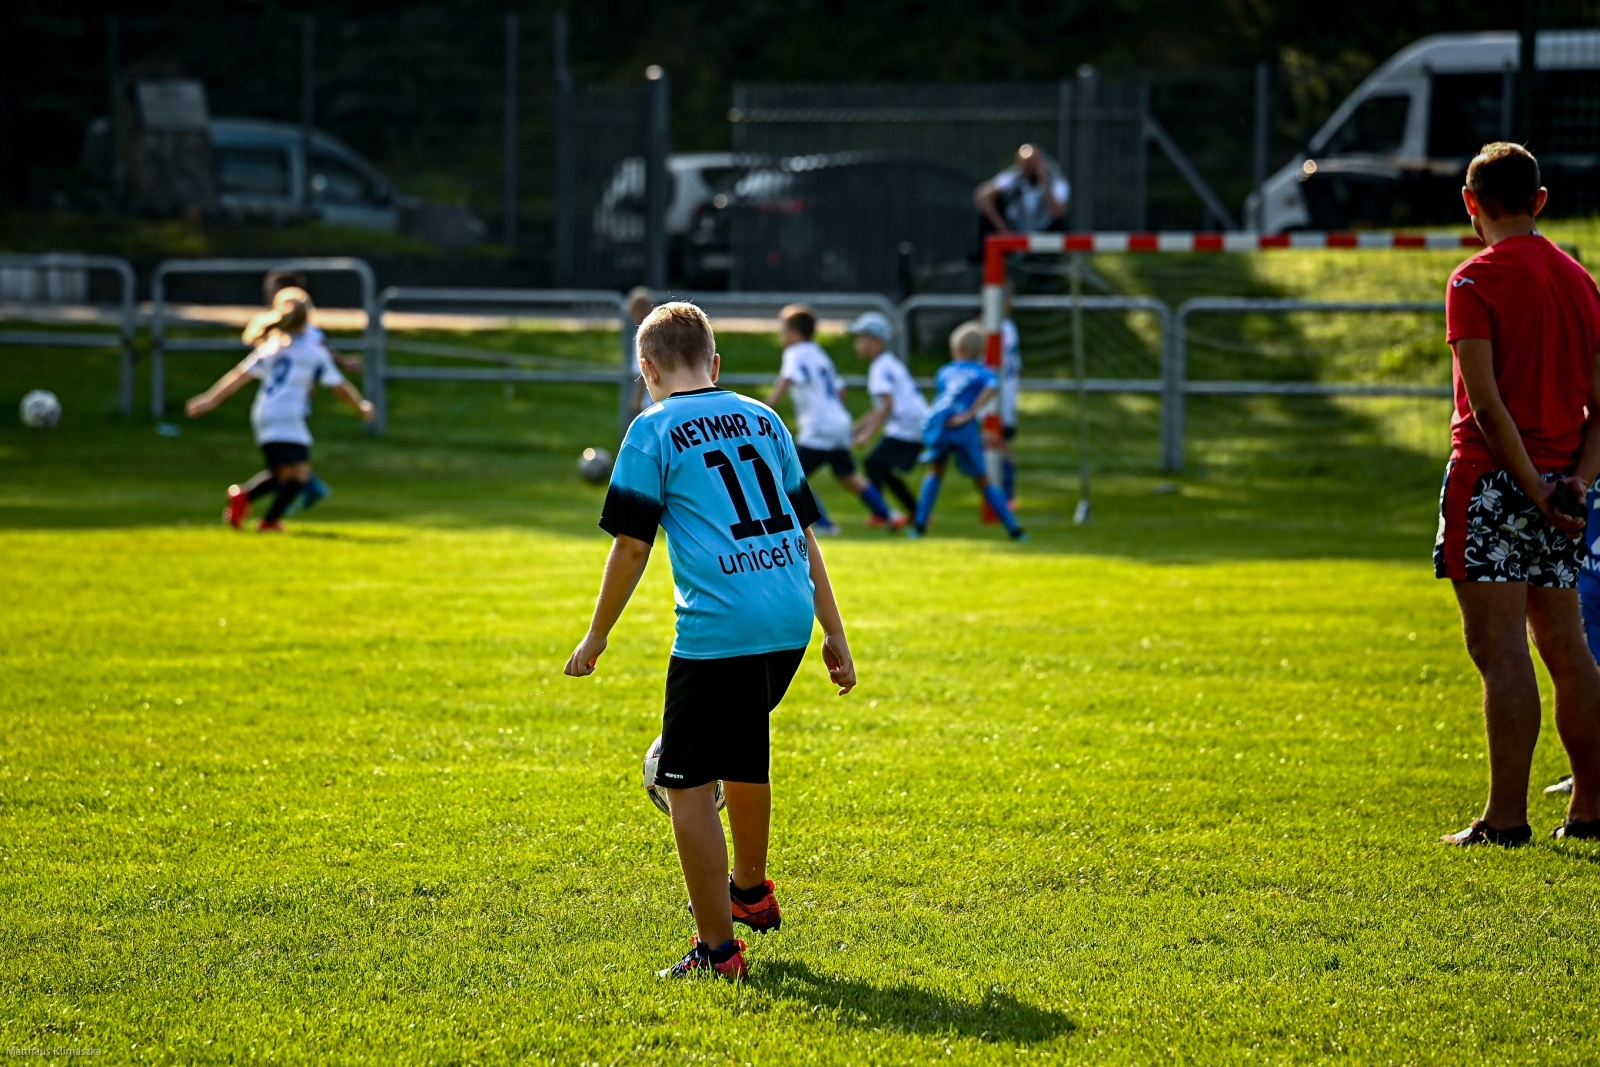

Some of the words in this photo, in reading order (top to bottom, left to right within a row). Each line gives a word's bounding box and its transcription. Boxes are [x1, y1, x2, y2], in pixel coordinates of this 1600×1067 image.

[669, 413, 752, 453] NEYMAR
[703, 444, 794, 540] 11
[718, 538, 794, 575] unicef
